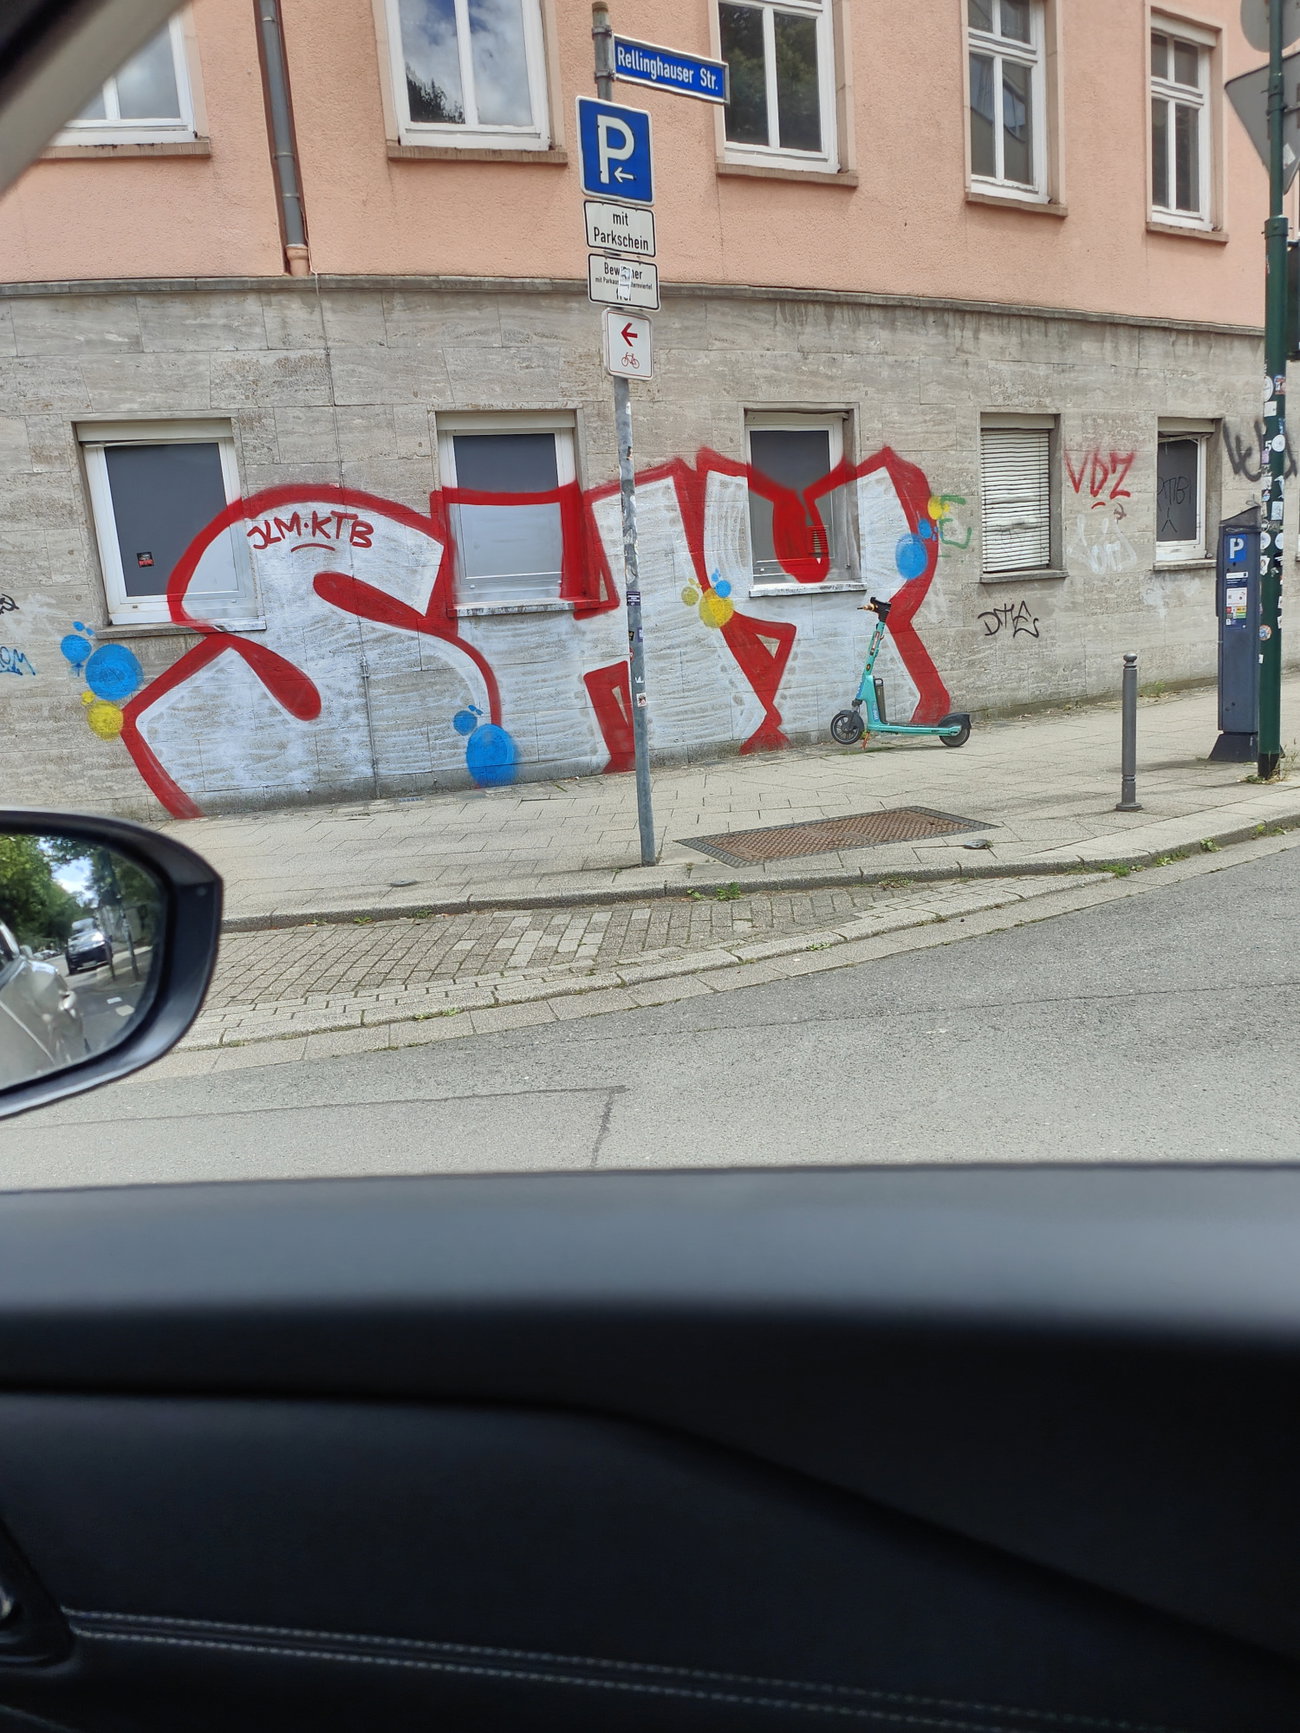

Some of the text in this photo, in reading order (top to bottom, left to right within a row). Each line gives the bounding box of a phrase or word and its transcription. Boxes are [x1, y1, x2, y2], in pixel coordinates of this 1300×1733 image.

[617, 46, 719, 91] Rellinghauser Str.
[597, 114, 635, 185] P
[612, 212, 629, 227] mit
[593, 226, 649, 251] Parkschein
[603, 261, 643, 281] Bewner
[1229, 537, 1245, 559] P
